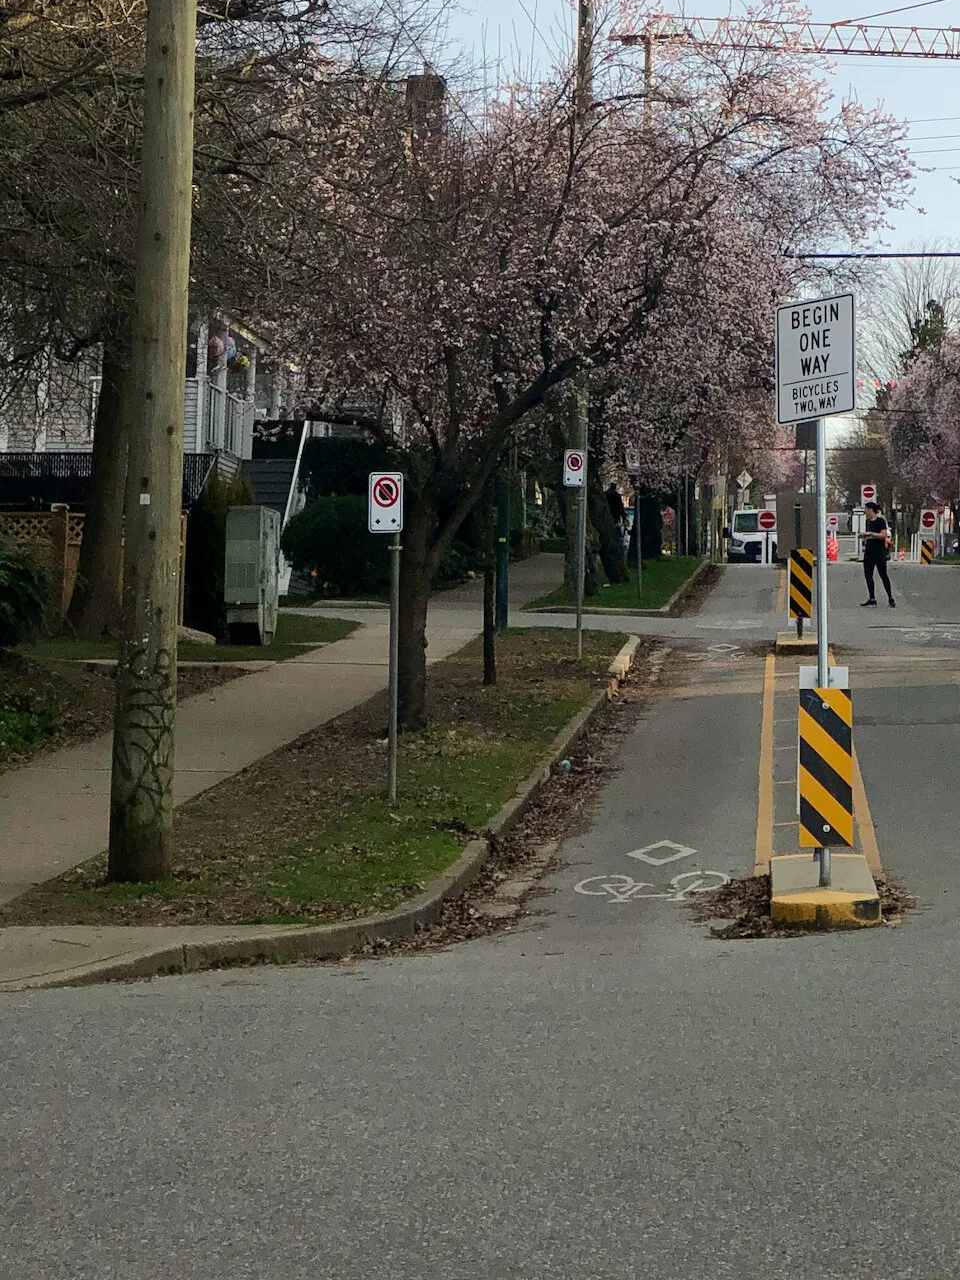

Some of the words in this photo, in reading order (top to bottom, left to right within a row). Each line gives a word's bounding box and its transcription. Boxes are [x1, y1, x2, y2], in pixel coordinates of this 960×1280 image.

[791, 302, 839, 330] BEGIN
[799, 328, 831, 352] ONE
[800, 353, 830, 377] WAY
[792, 380, 839, 400] BICYCLES
[794, 400, 814, 415] TWO
[819, 395, 837, 410] WAY
